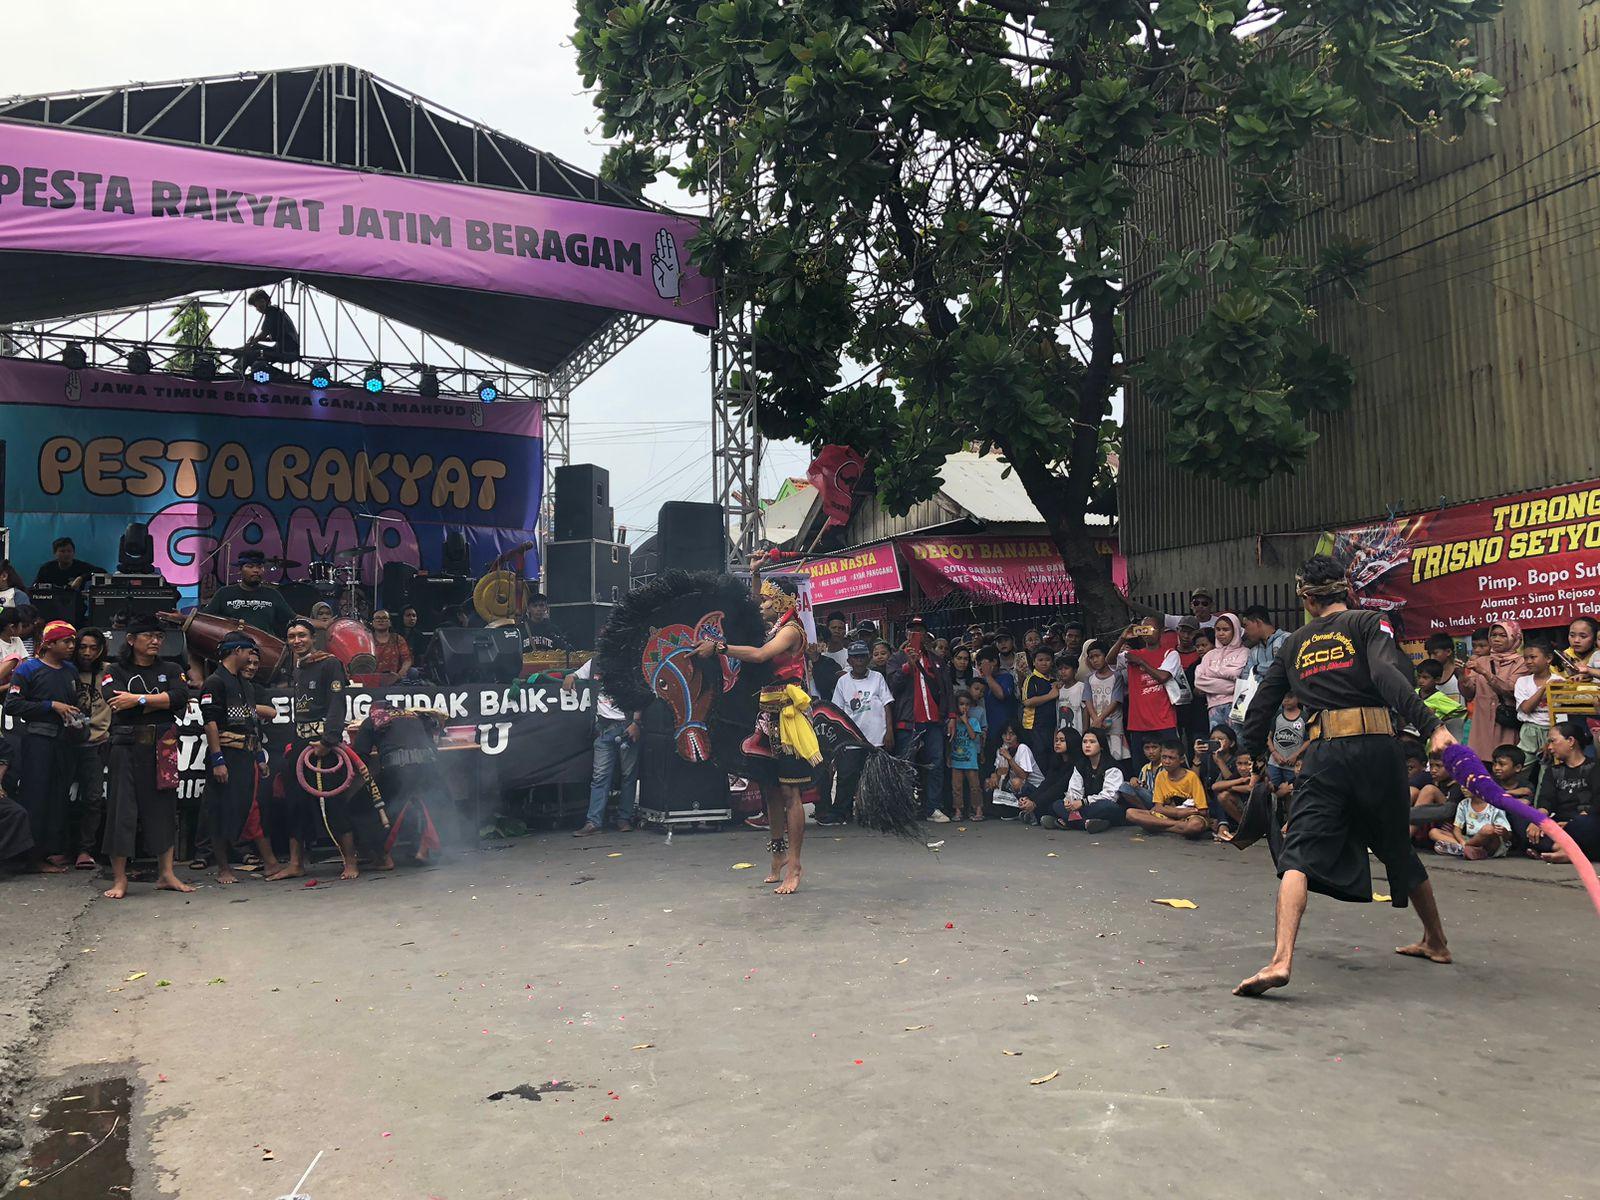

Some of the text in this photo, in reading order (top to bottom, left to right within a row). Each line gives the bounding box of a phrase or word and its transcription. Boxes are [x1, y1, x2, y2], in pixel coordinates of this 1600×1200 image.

[0, 165, 642, 276] PESTA RAKYAT JATIM BERAGAM
[90, 382, 466, 417] JAWA TIMUR BERSAMA GANJAR MAHFUD
[38, 436, 507, 511] PESTA RAKYAT
[1493, 489, 1600, 532] TURONG
[146, 501, 422, 586] GAMA
[913, 542, 1052, 560] DEPOT BANJAR
[1411, 521, 1600, 584] TRISNO SETYO
[840, 552, 877, 571] NASYA
[943, 565, 1004, 575] SOTO BANJAR
[1027, 565, 1044, 573] MIE
[1478, 576, 1522, 591] Pimp.
[1528, 568, 1570, 585] Bopo
[1481, 598, 1518, 609] Alamat
[1528, 593, 1555, 604] Simo
[1558, 588, 1595, 600] Rejoso
[1431, 619, 1447, 628] No.
[1449, 615, 1476, 627] Induk
